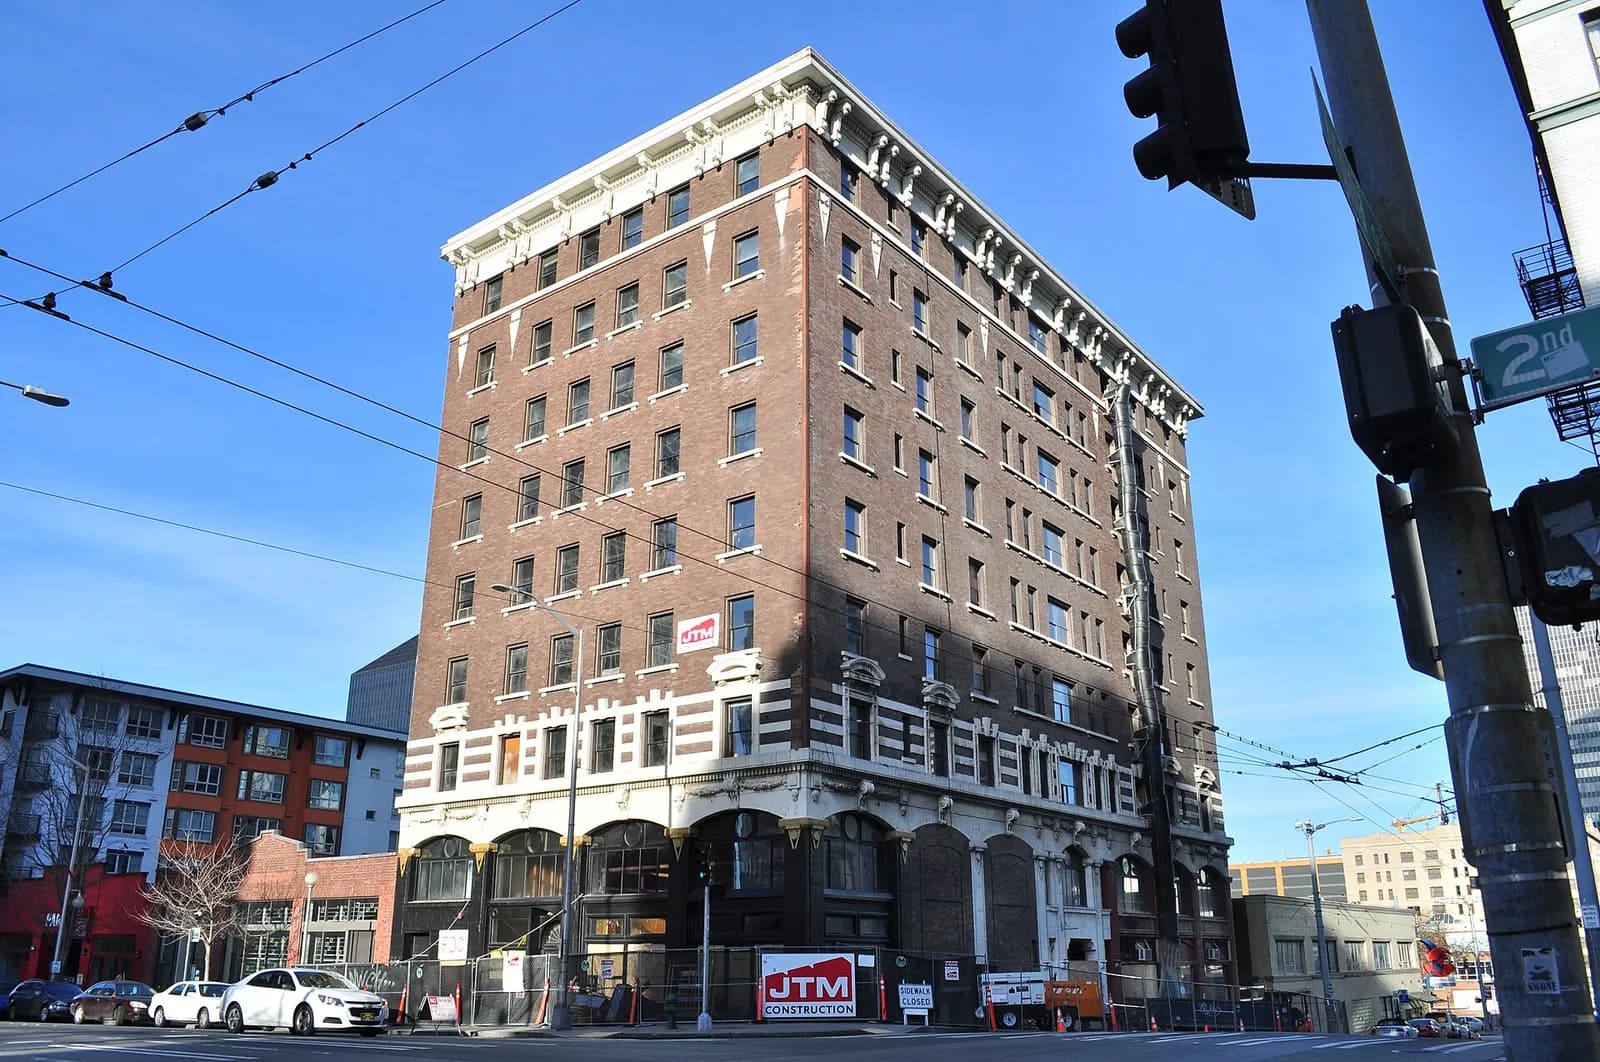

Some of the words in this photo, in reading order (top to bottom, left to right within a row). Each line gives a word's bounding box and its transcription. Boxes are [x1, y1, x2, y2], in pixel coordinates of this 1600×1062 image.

[1496, 321, 1575, 388] 2nd
[682, 626, 713, 643] JTM
[769, 976, 849, 999] JTM
[900, 987, 931, 995] SIDEWALK
[902, 998, 931, 1006] CLOSED
[764, 1004, 854, 1015] CONSTRUCTION
